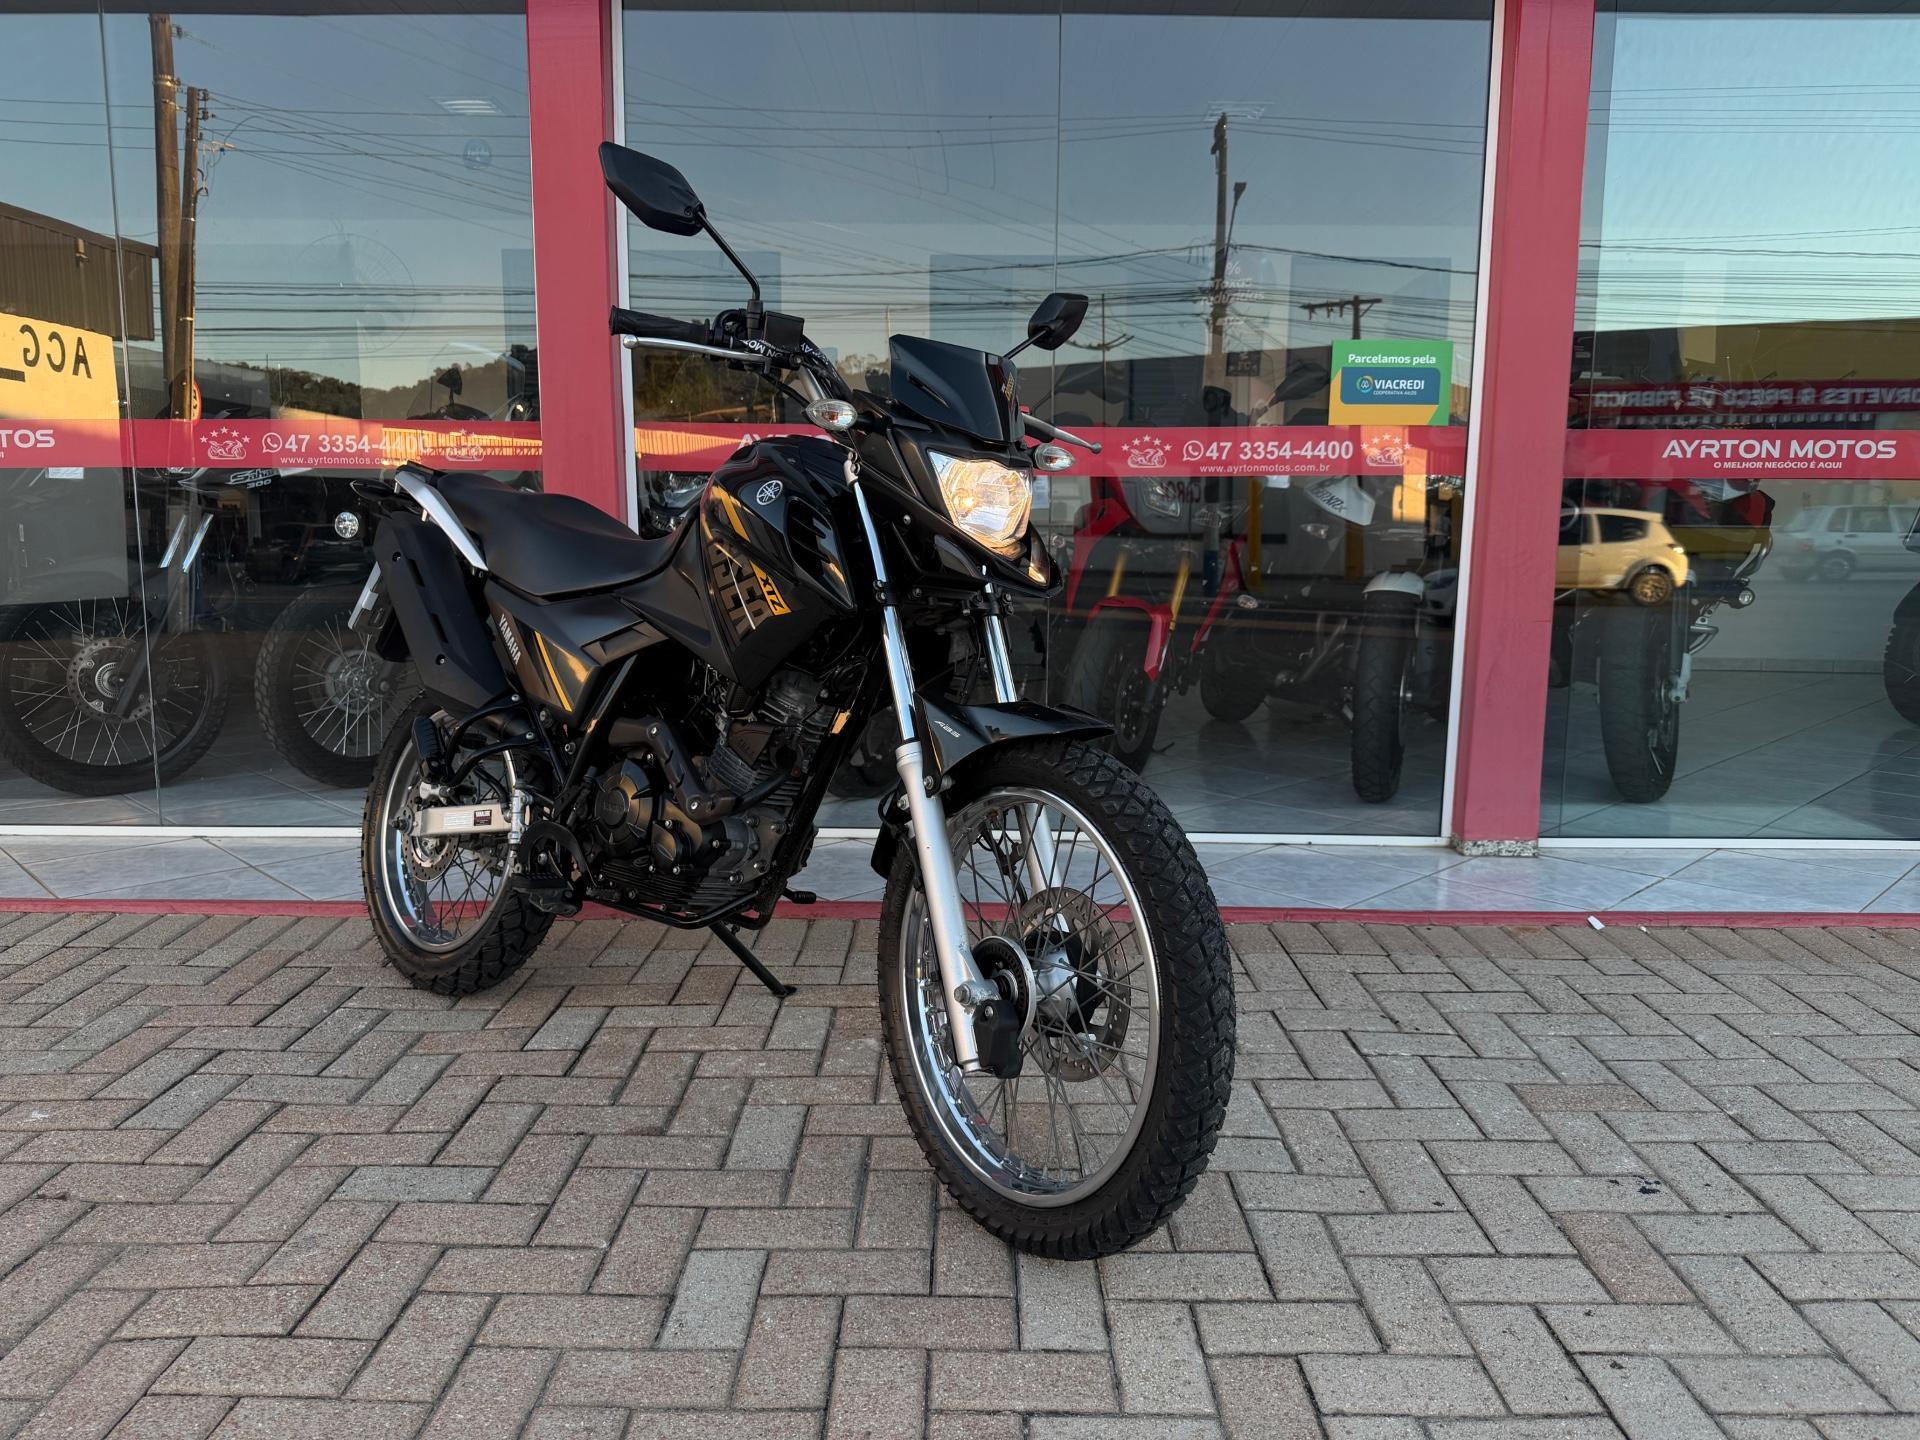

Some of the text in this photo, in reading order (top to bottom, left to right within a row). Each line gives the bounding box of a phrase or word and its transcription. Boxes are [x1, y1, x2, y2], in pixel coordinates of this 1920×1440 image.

[1348, 353, 1437, 366] Parcelamos pela
[1374, 379, 1425, 390] VIACREDI
[285, 434, 310, 453] 47
[1205, 441, 1354, 461] 47 3354-4400
[1661, 439, 1897, 459] AYRTON MOTOS
[1199, 463, 1330, 473] www.ayrtonmotos.com.br
[1713, 460, 1843, 469] O MELHOR NEGÓCIO É AQUI
[246, 479, 272, 489] 300
[760, 575, 785, 612] XTZ
[499, 613, 521, 665] YAMAHA
